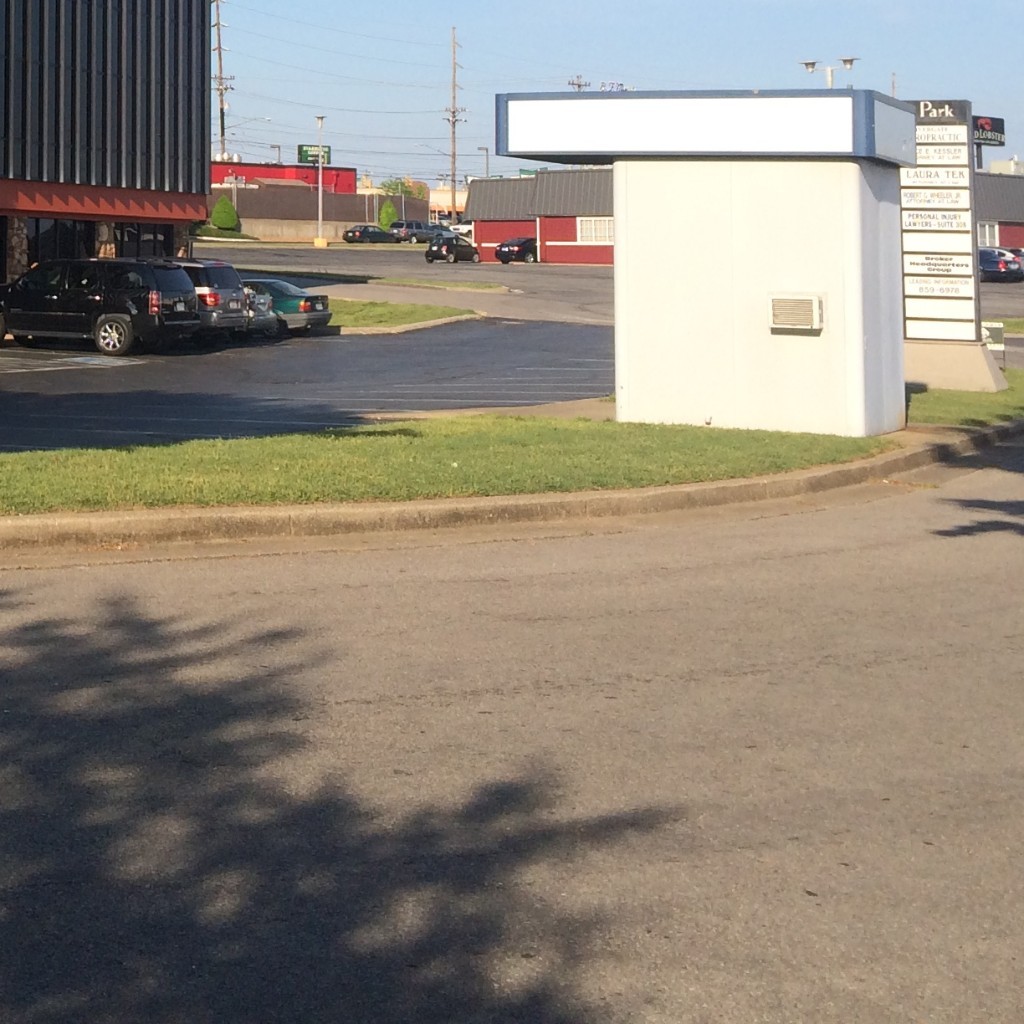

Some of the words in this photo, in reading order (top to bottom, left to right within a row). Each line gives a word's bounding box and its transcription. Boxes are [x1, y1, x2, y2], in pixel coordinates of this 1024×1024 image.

[919, 101, 954, 118] Park
[916, 133, 962, 142] ROPRACTIC
[906, 170, 940, 179] LAURA
[945, 170, 965, 179] TEK
